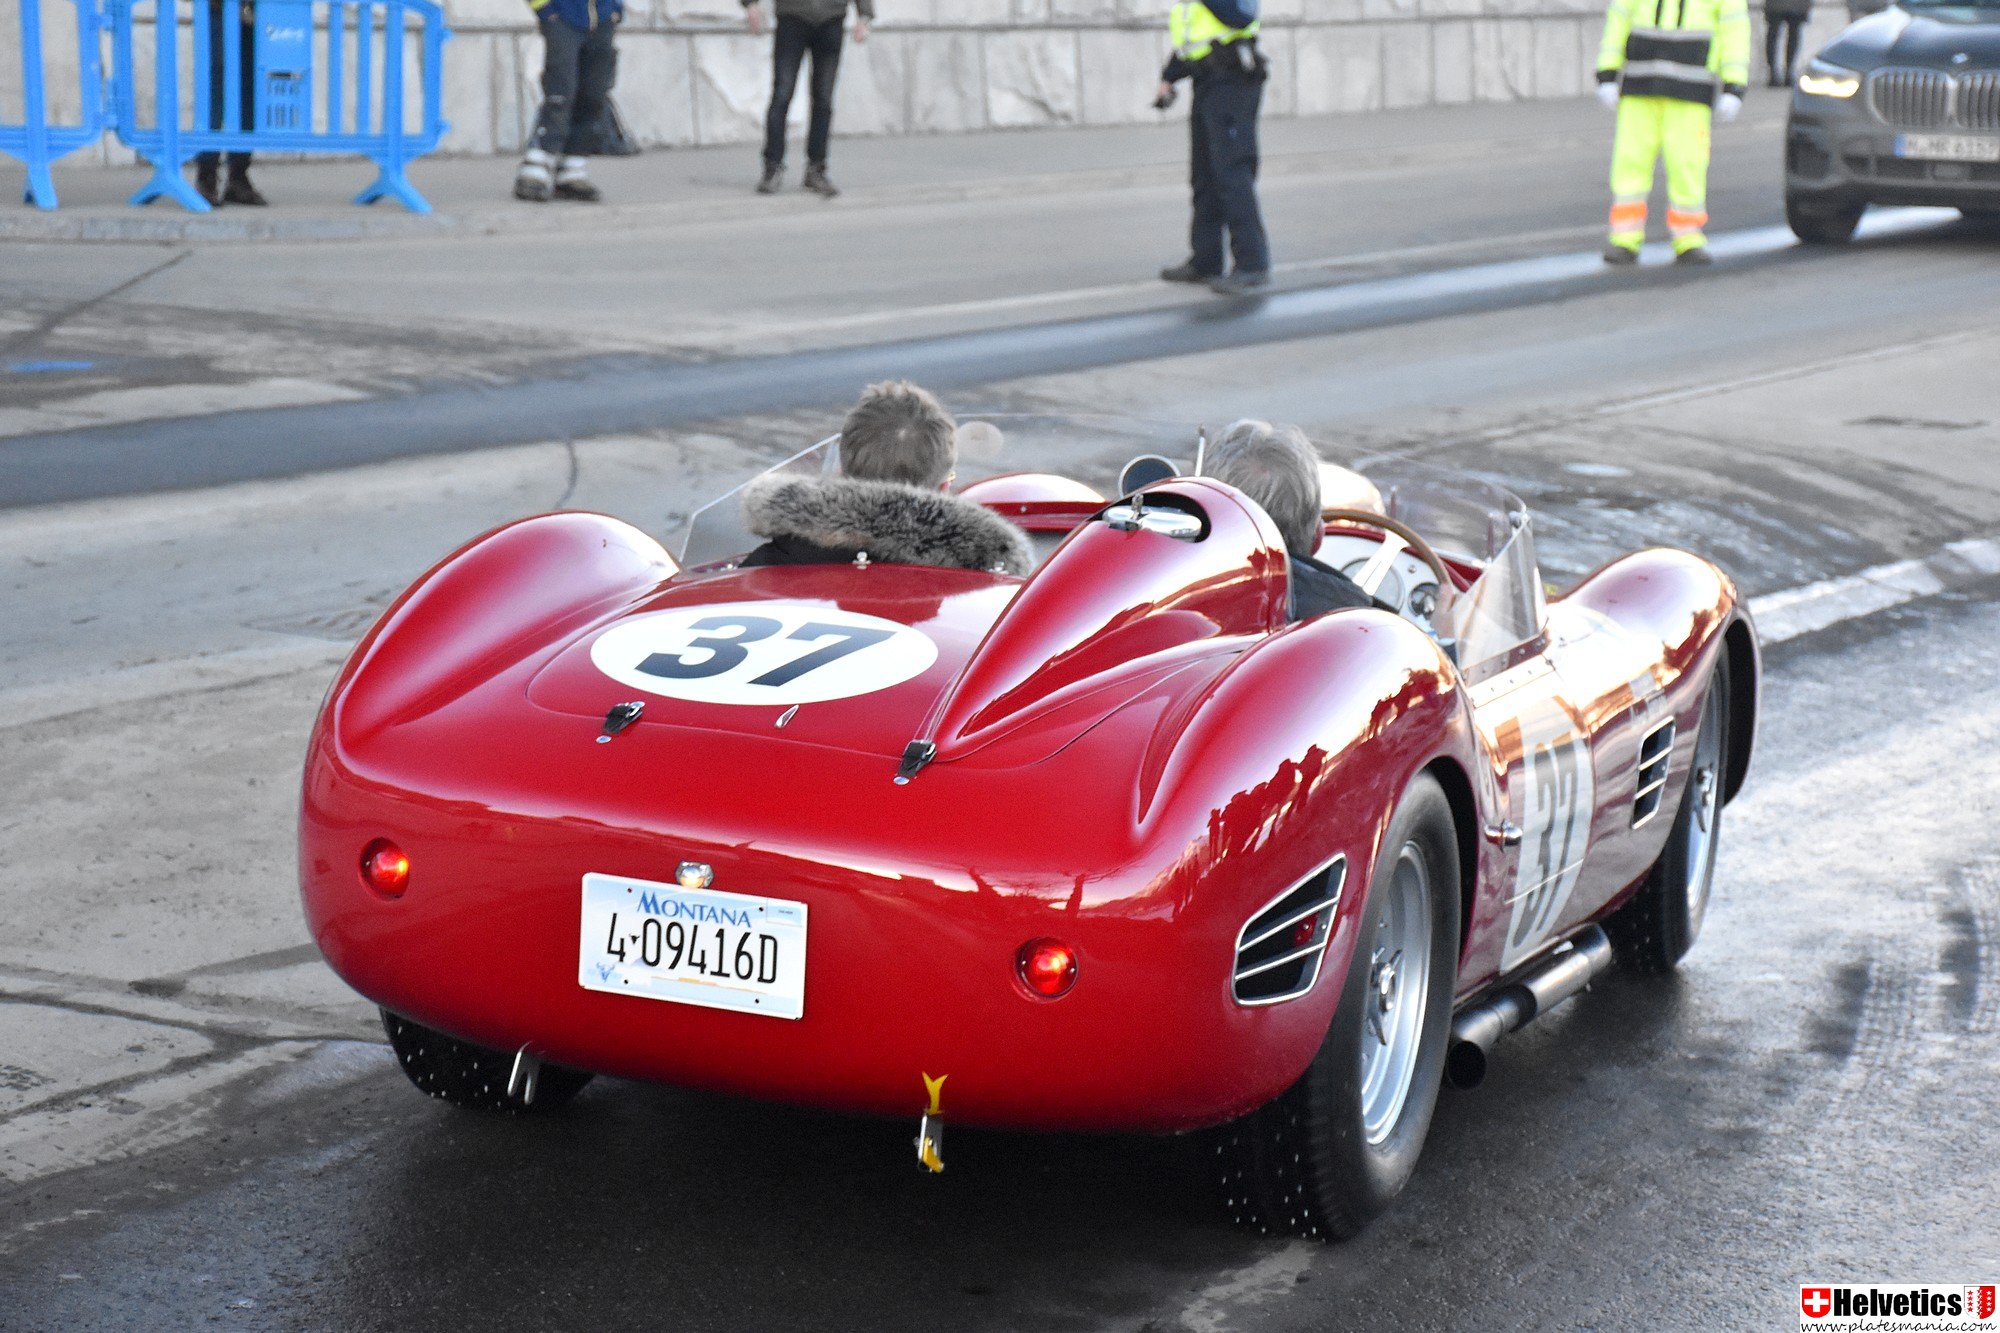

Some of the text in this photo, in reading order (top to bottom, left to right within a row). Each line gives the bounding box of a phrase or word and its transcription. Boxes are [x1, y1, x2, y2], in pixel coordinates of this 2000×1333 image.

[634, 615, 898, 687] 37
[1512, 733, 1579, 948] 37
[637, 890, 752, 928] MONTANA
